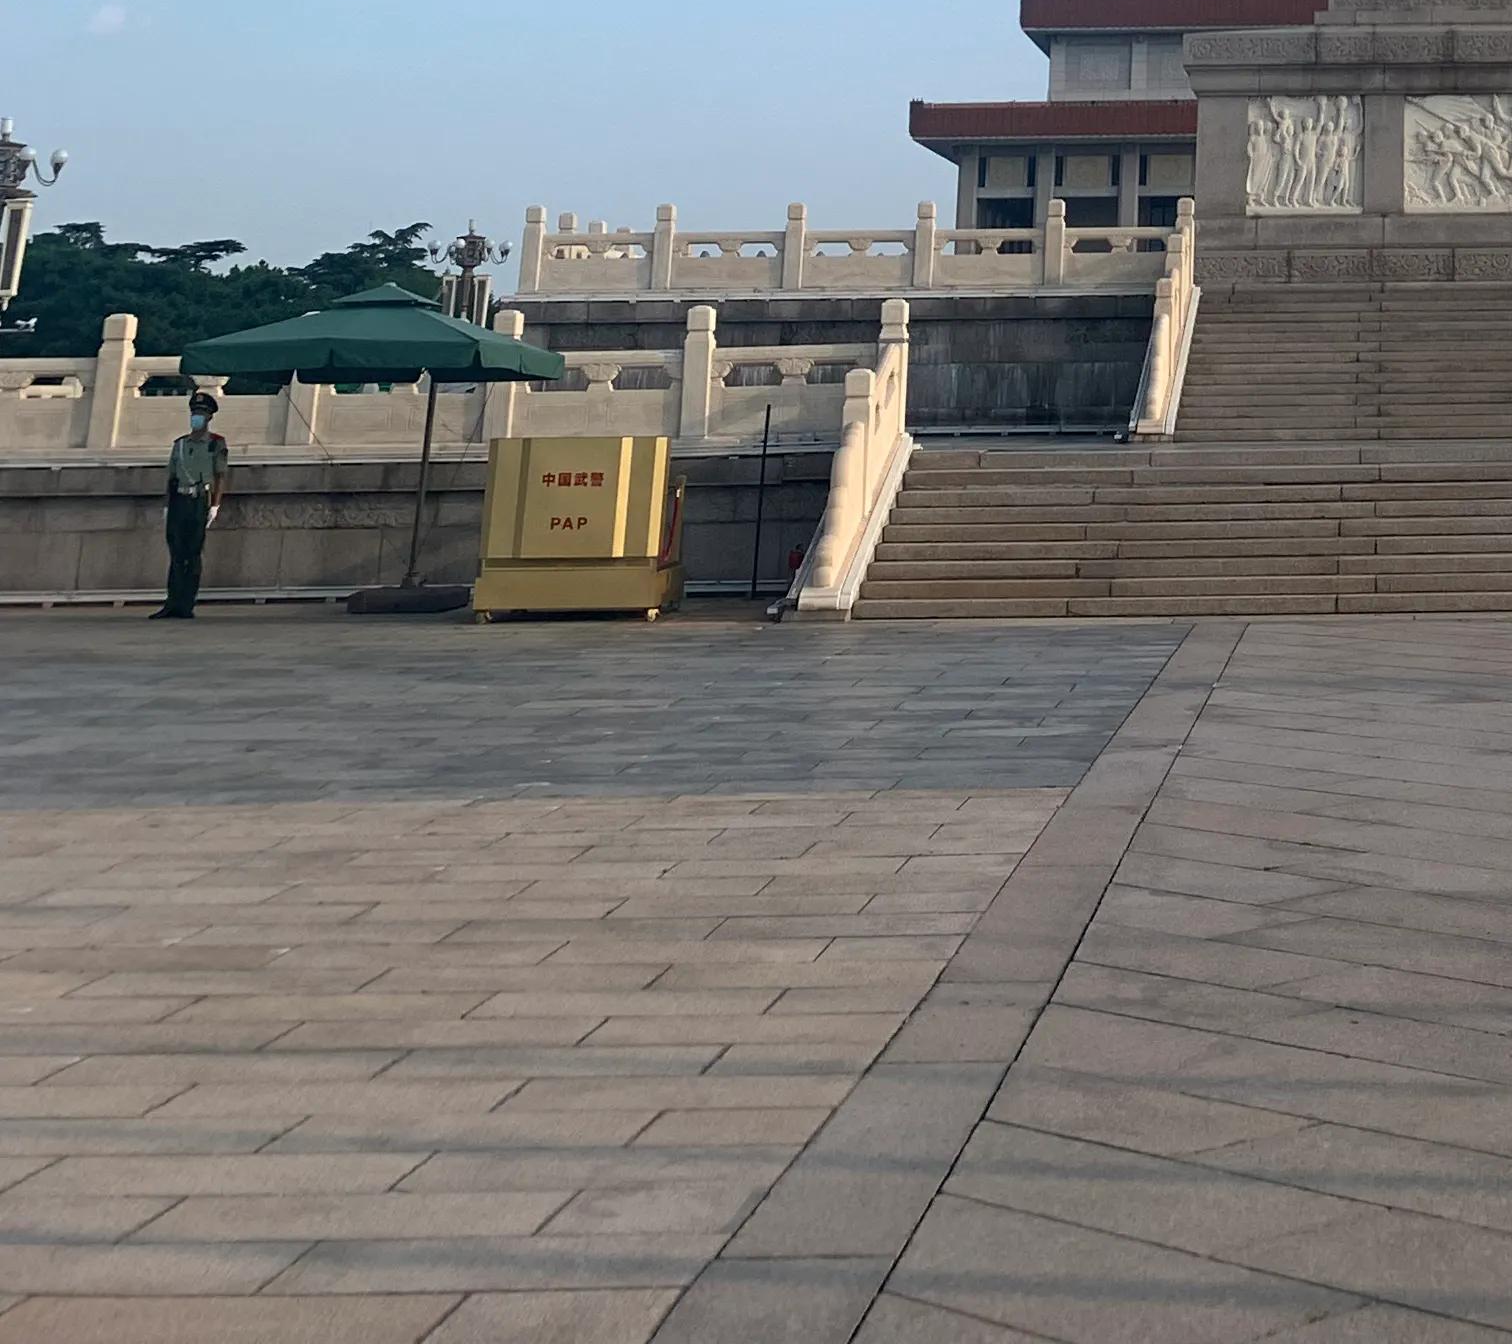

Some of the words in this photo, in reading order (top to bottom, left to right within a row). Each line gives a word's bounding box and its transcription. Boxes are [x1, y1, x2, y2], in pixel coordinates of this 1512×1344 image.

[542, 472, 604, 487] 中国武警
[550, 517, 588, 530] PAP
